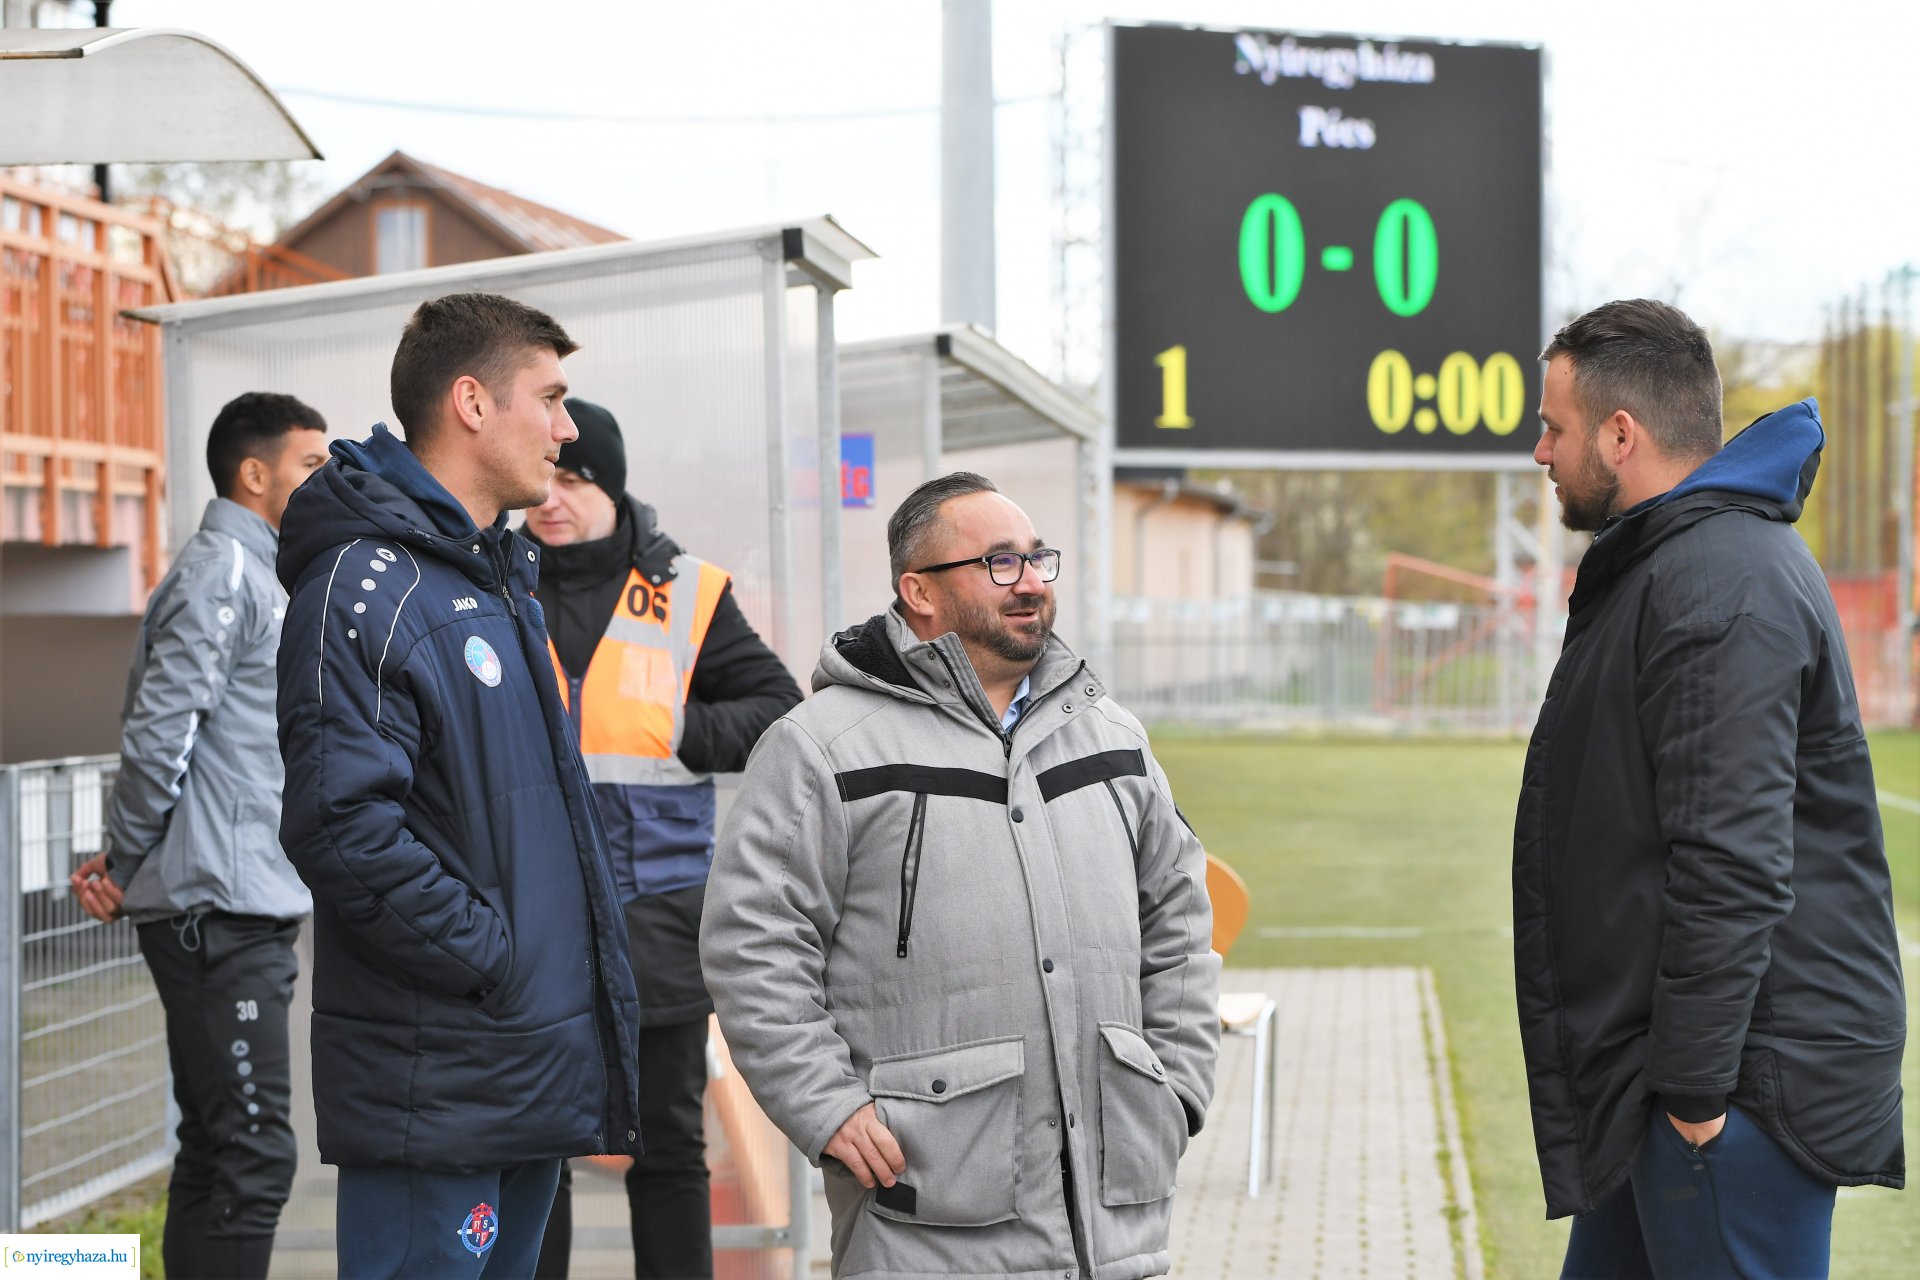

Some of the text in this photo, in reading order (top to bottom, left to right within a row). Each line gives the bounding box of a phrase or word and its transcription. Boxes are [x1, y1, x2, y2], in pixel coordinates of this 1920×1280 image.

[1238, 192, 1306, 314] 0
[1373, 197, 1439, 318] 0
[1154, 344, 1194, 430] 1
[1367, 348, 1525, 437] 0:00
[452, 597, 478, 612] JAKO
[236, 1000, 259, 1021] 30
